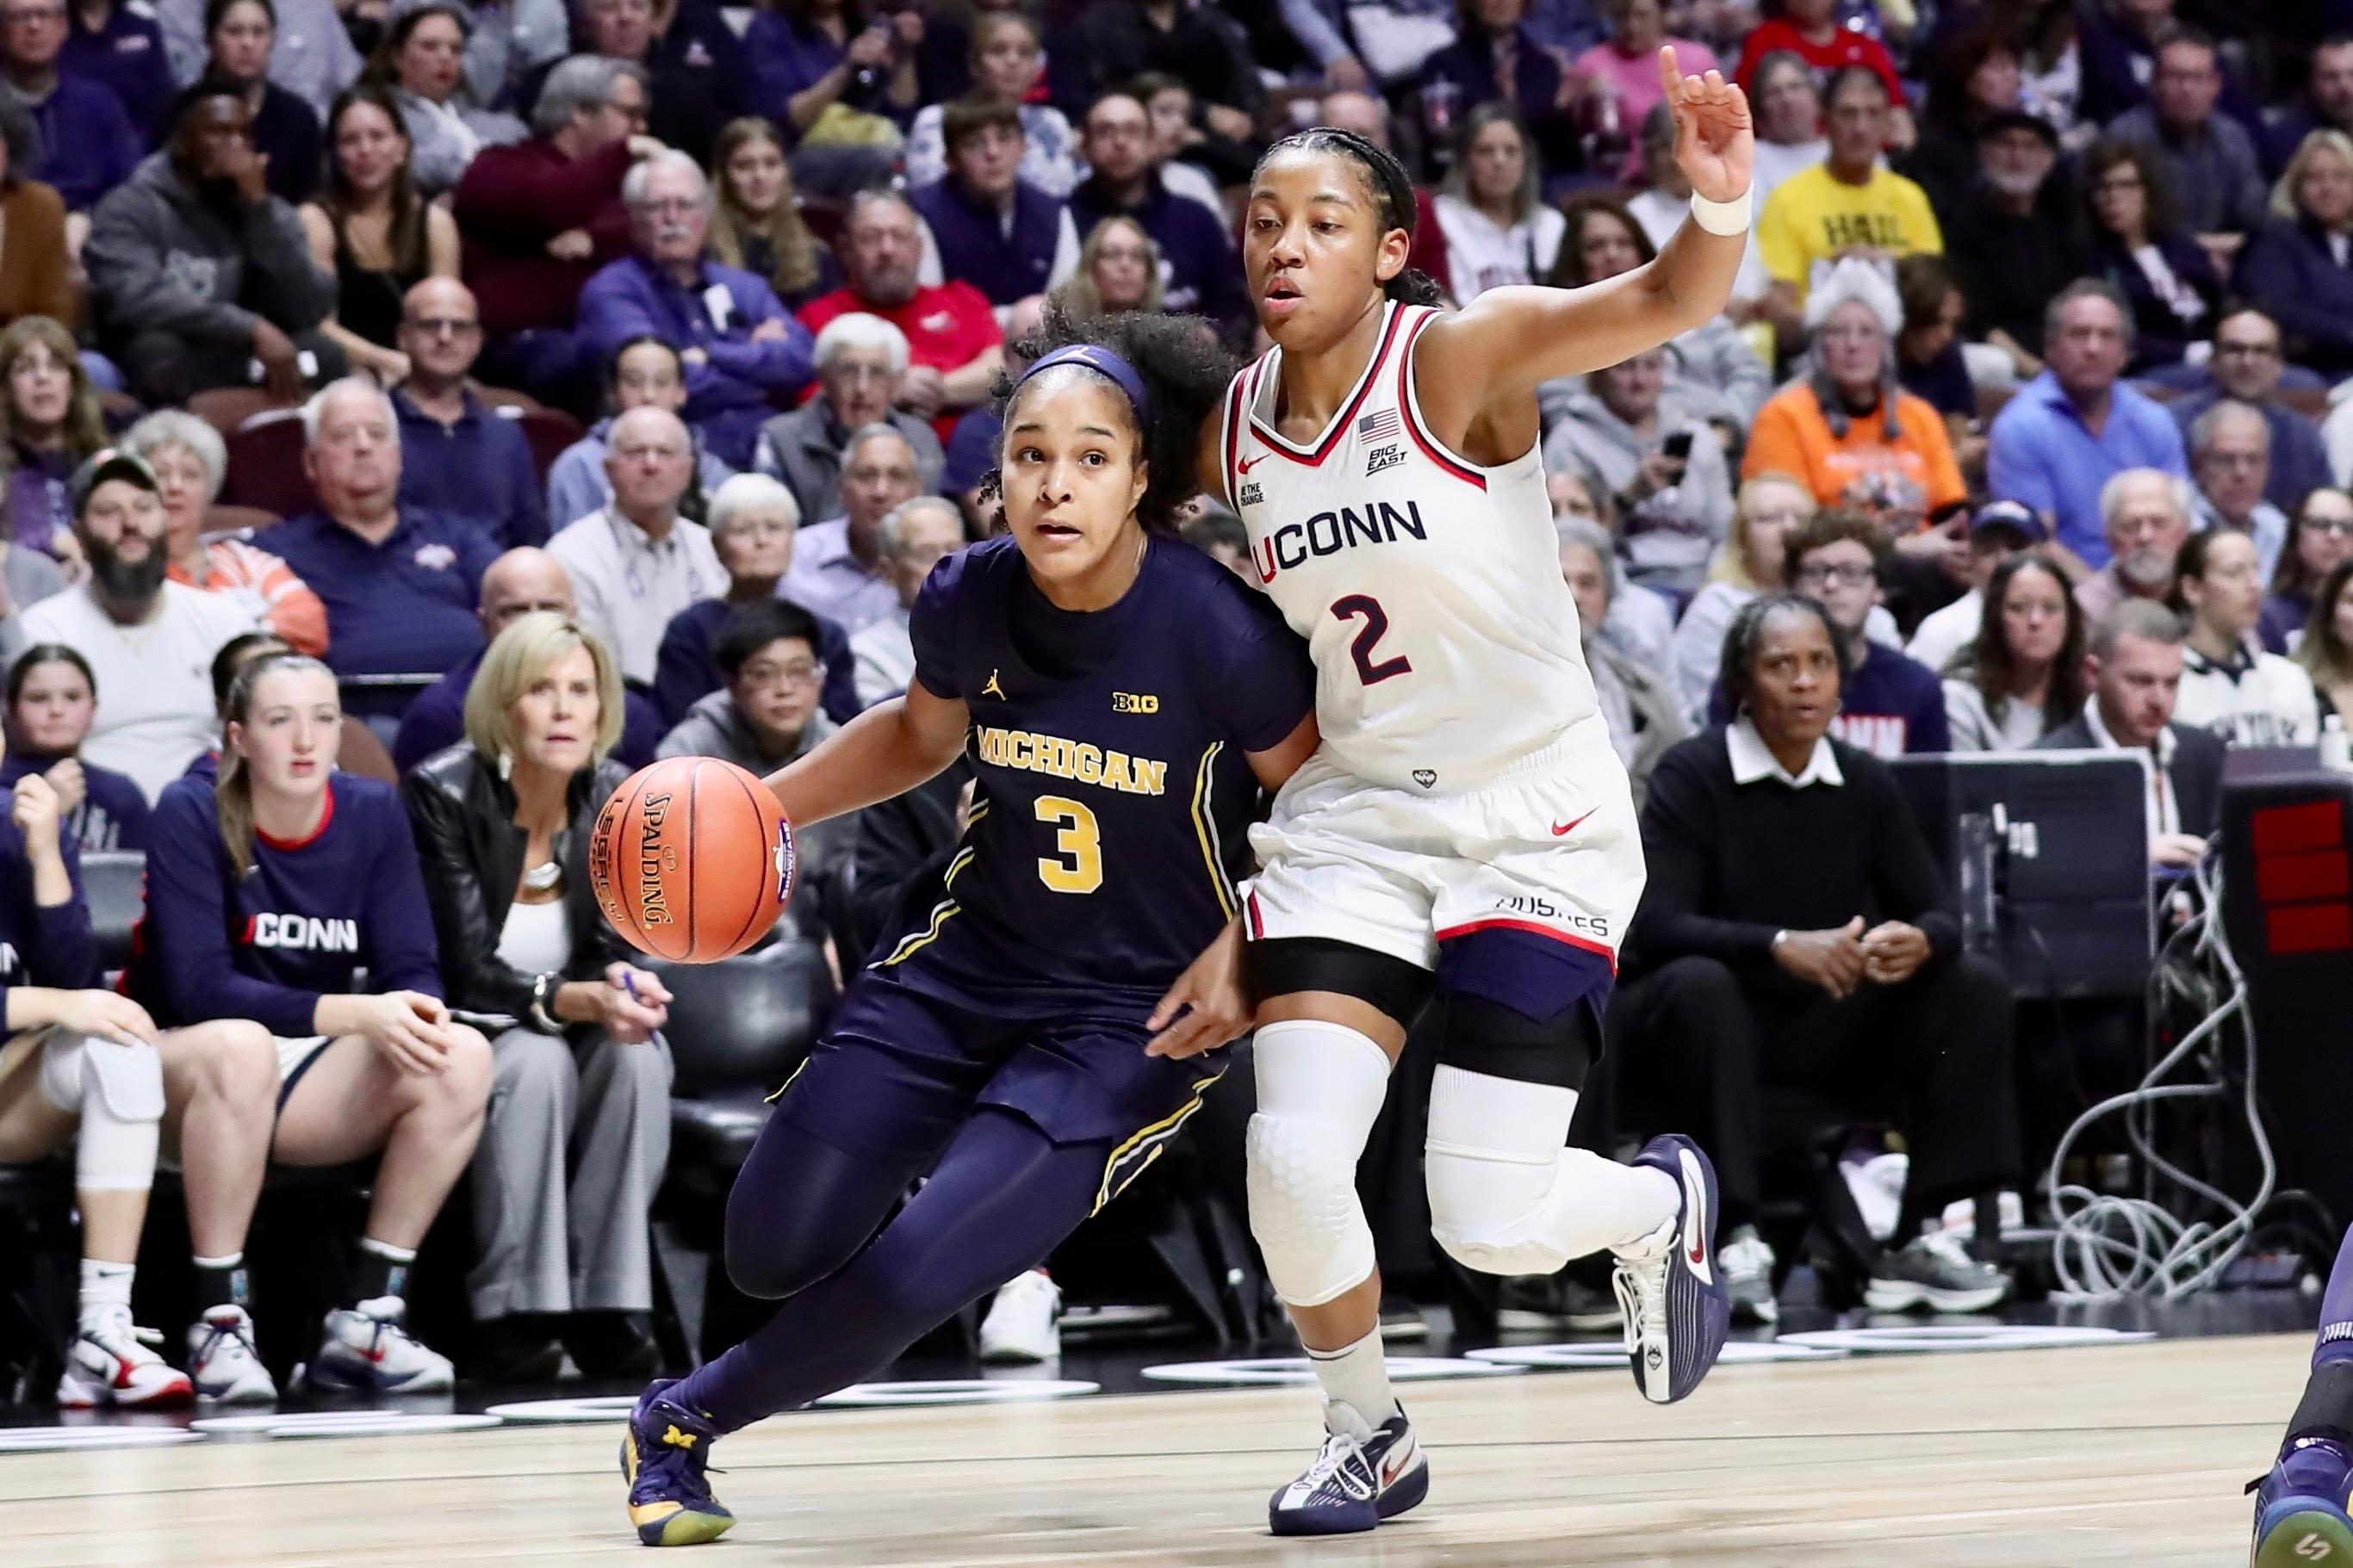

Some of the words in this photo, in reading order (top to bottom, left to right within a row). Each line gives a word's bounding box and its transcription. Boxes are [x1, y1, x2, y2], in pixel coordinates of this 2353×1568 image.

[1247, 482, 1261, 494] THE
[1367, 451, 1407, 471] EAST
[1369, 443, 1397, 461] BIG
[1252, 500, 1427, 584] UCONN
[1330, 593, 1412, 686] 2
[977, 724, 1167, 796] MICHIGAN
[641, 793, 674, 926] SPALDING
[1034, 795, 1103, 895] 3
